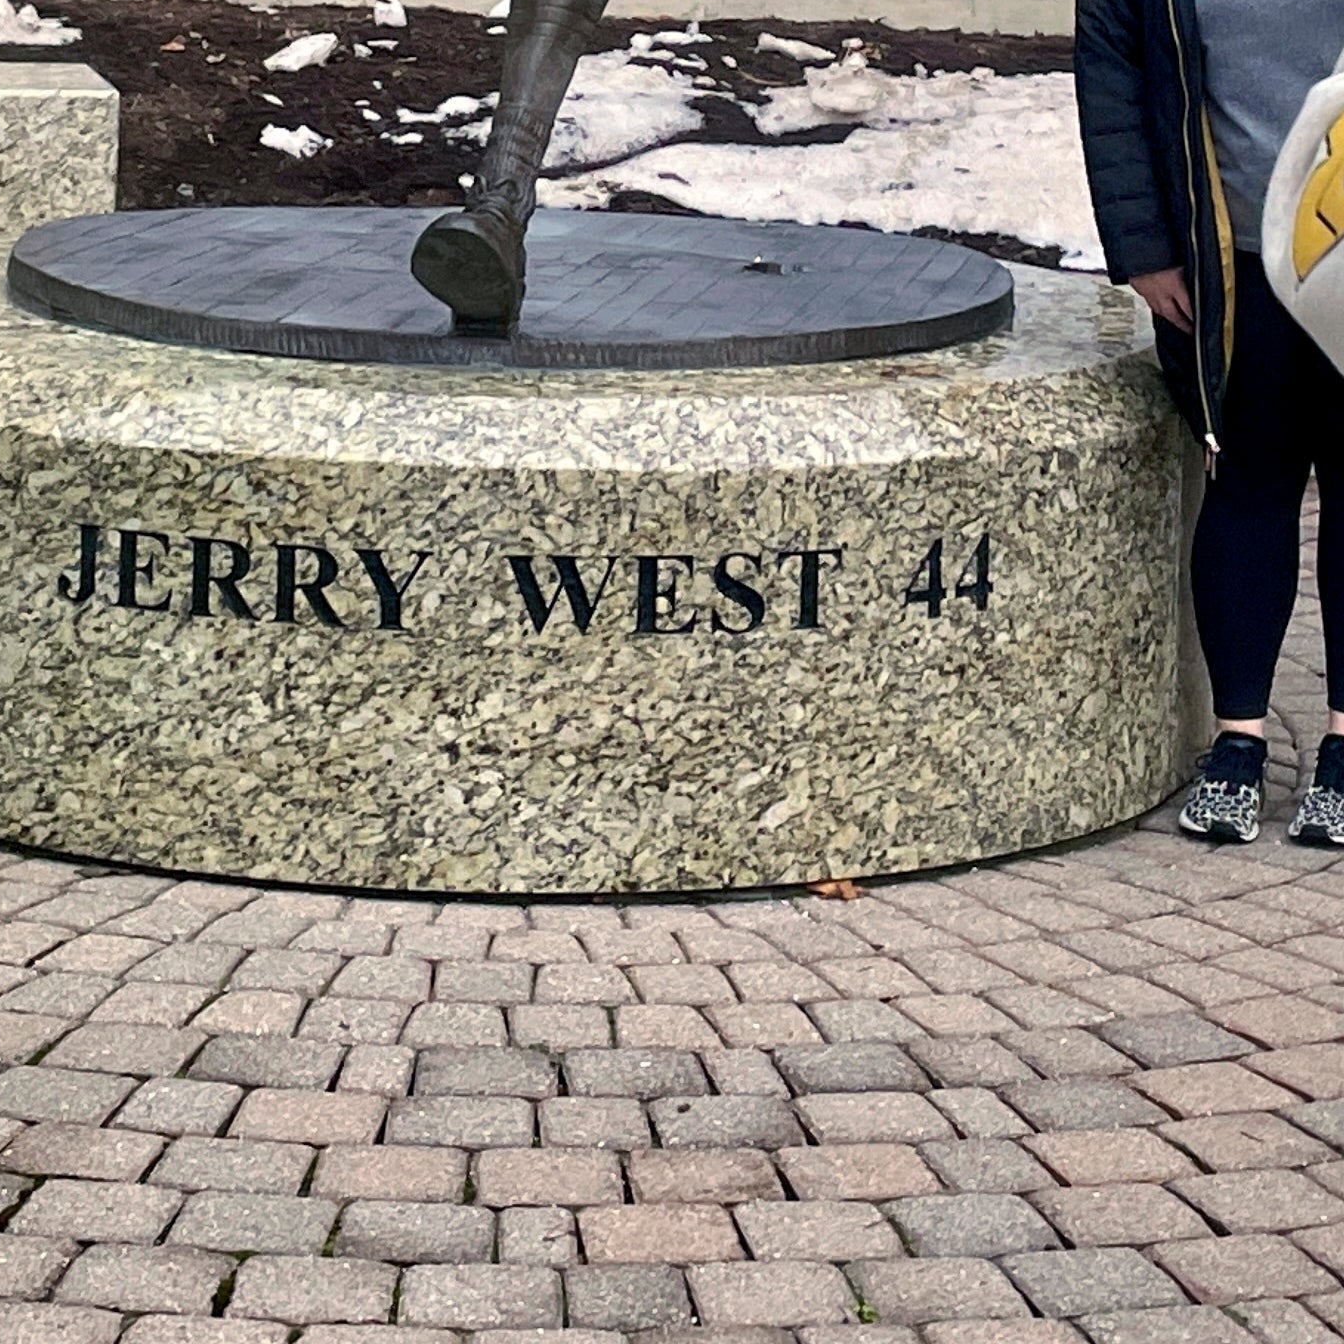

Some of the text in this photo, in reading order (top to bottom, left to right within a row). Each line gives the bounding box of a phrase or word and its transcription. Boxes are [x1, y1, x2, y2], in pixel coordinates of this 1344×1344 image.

[57, 523, 994, 636] JERRY WEST 44
